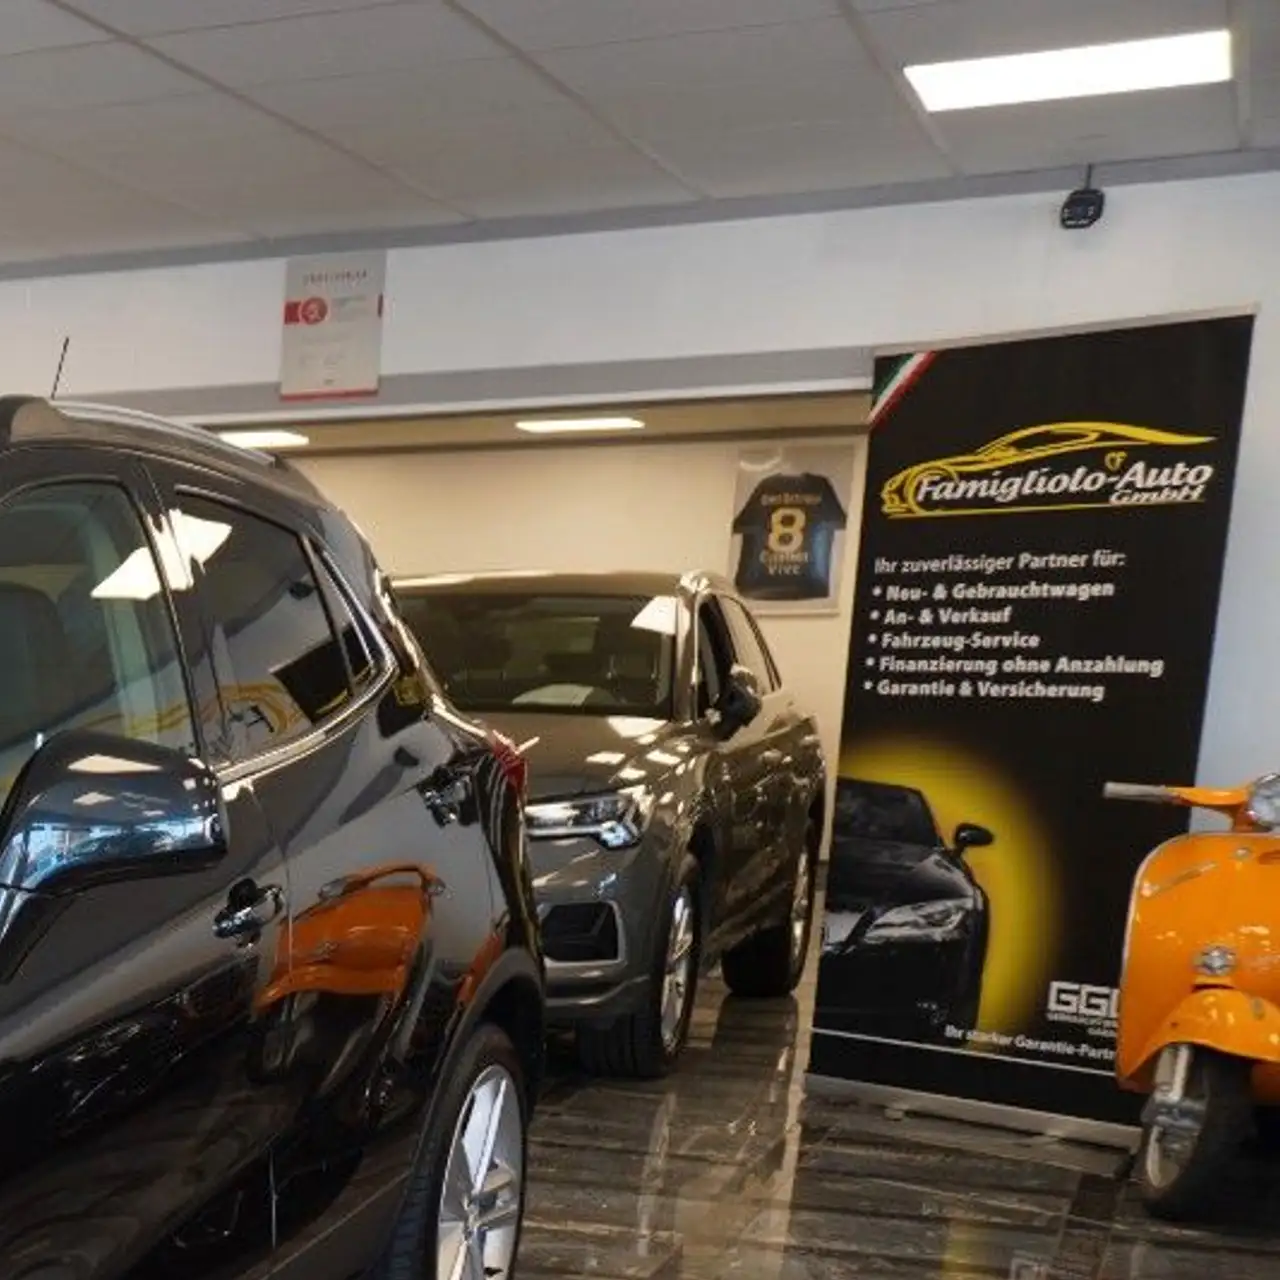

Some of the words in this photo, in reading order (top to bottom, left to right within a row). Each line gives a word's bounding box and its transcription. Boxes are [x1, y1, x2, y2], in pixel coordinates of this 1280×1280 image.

[916, 460, 1214, 503] Famigliolo-Auto
[768, 507, 806, 552] 8
[874, 556, 897, 574] Ihr
[902, 554, 1014, 574] zuverlässiger
[1018, 552, 1089, 569] Partner
[1092, 550, 1126, 567] für:
[886, 585, 928, 601] Neu-
[932, 583, 948, 600] &
[952, 580, 1115, 601] Gebrauchtwagen
[884, 608, 915, 624] An-
[918, 608, 933, 624] &
[939, 605, 1013, 623] Verkauf
[881, 630, 1040, 651] Fahrzeug-Service
[879, 655, 998, 676] Finanzierung
[1002, 655, 1051, 674] ohne
[1054, 655, 1165, 678] Anzahlung
[877, 679, 955, 696] Garantie
[959, 680, 973, 697] &
[977, 680, 1106, 702] Versicherung
